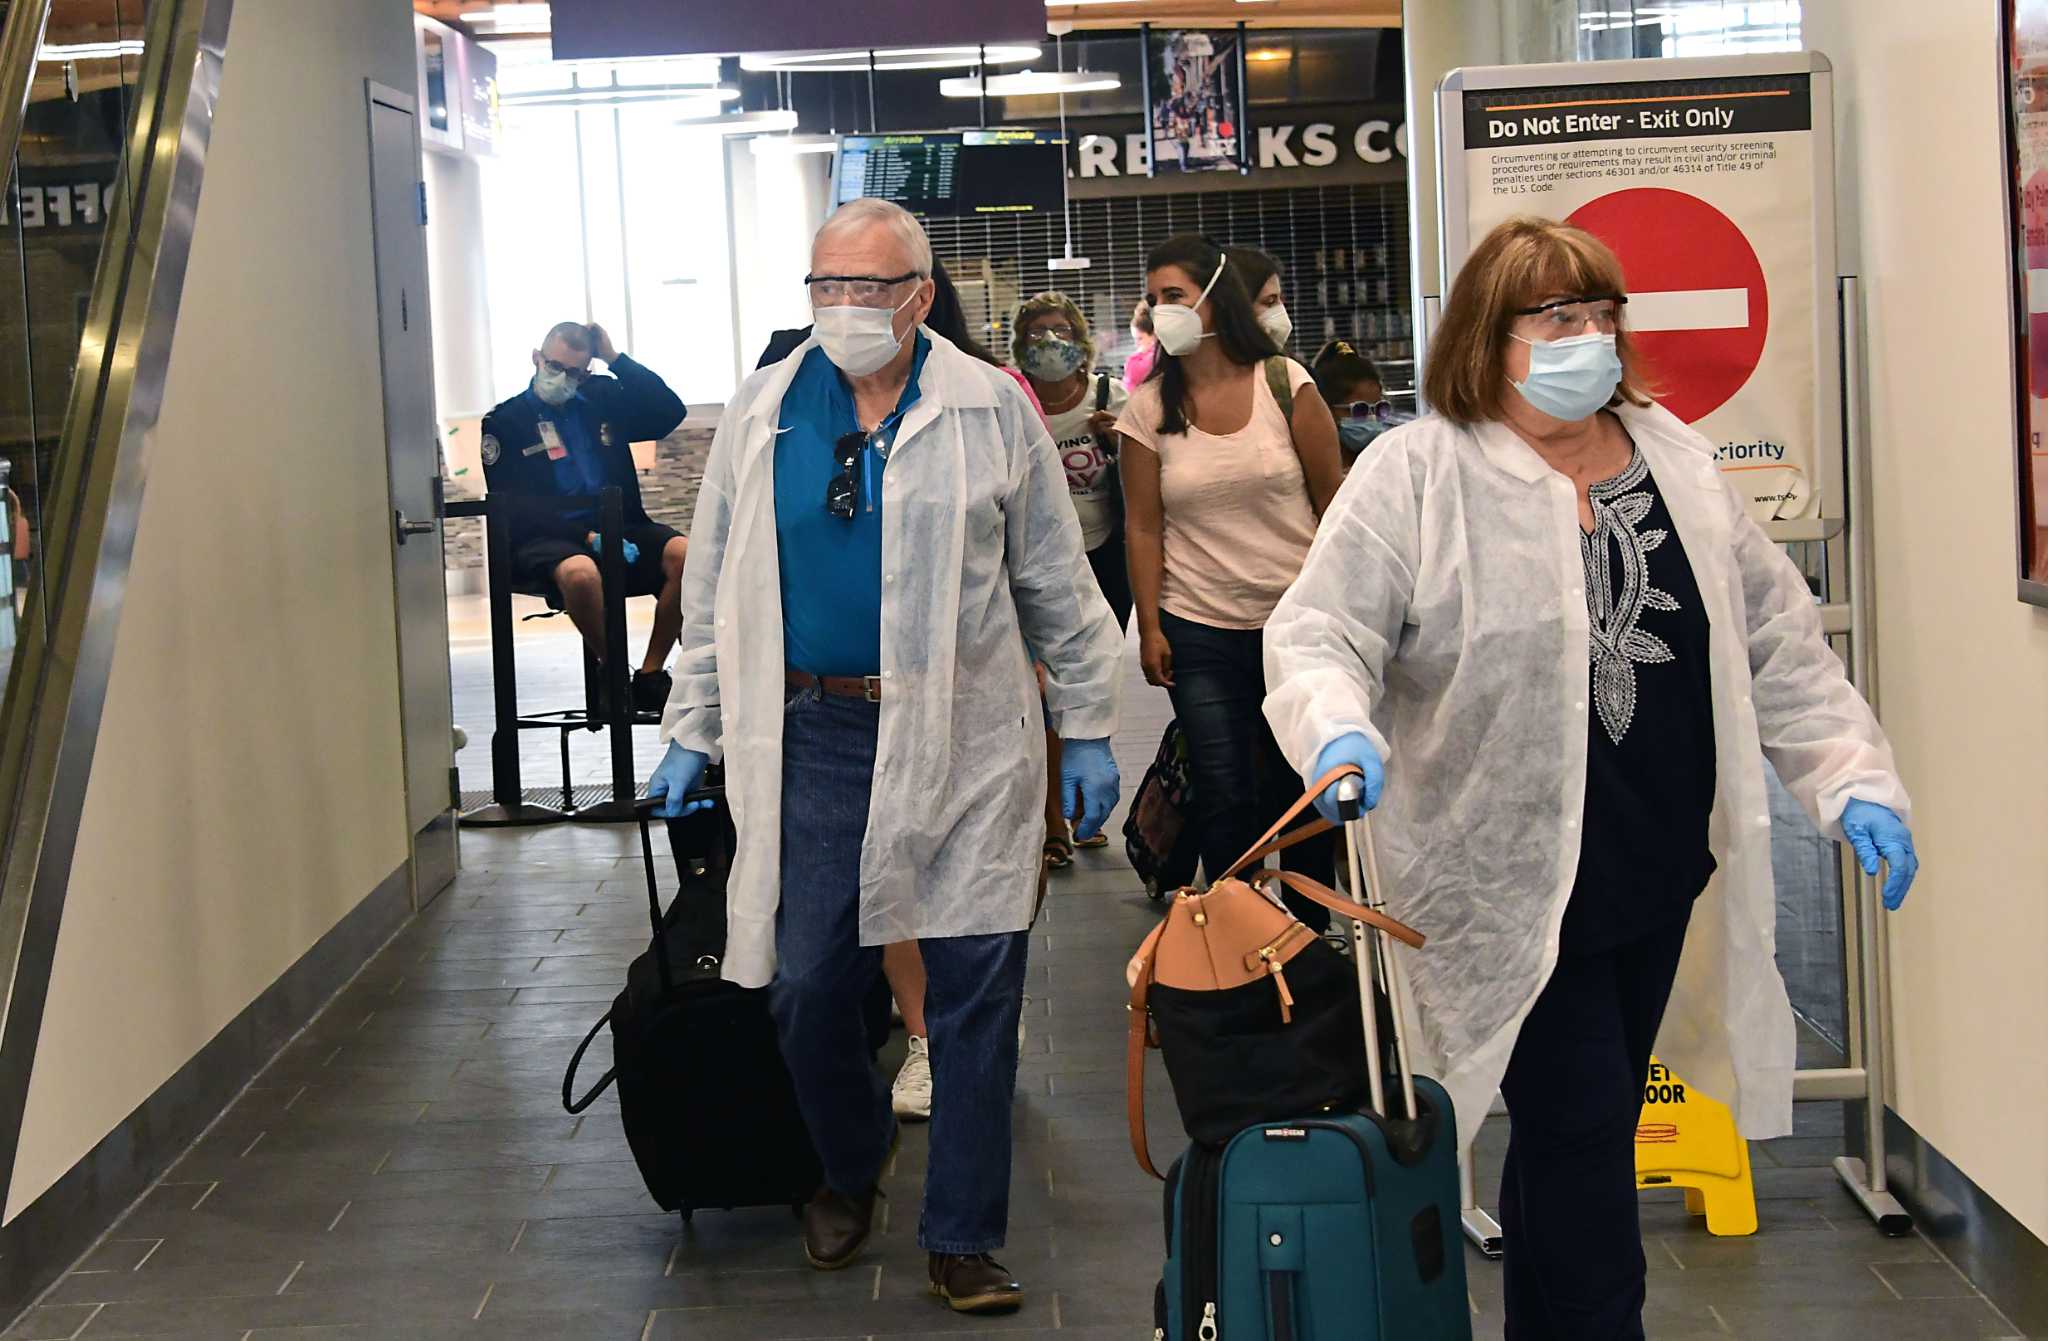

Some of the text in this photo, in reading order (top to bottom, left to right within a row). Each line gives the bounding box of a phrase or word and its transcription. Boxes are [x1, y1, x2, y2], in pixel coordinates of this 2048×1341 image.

[1489, 120, 1518, 139] Do
[1523, 117, 1561, 137] Not
[1565, 113, 1622, 133] Enter
[1639, 109, 1680, 129] Exit
[1685, 106, 1735, 128] Only
[1491, 141, 1774, 165] Circumventing or attempting to circumvent security screening
[1492, 149, 1777, 175] procedures or requirements may result in civil and/or criminal
[1492, 160, 1764, 186] penalties under sections 46301 and/or 46314 of Title 49 of
[1493, 185, 1508, 195] the
[1713, 440, 1785, 461] riority
[1644, 1084, 1686, 1104] OOR
